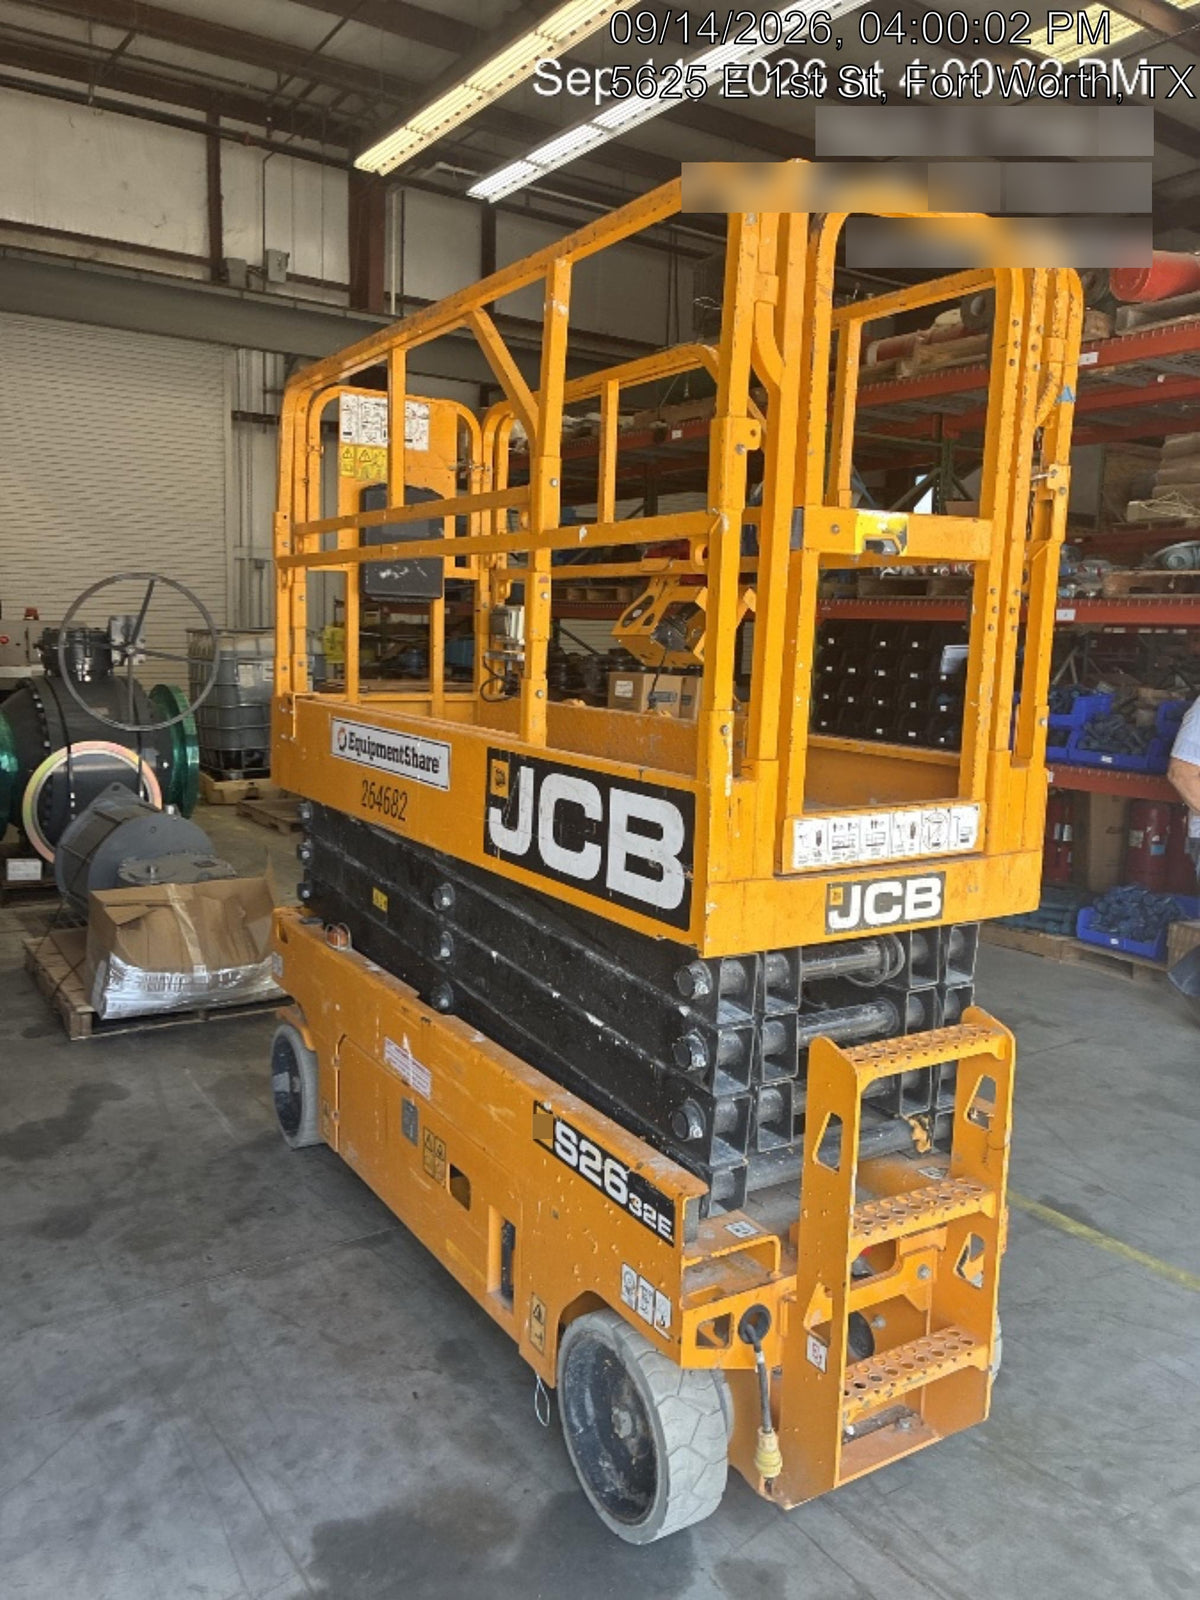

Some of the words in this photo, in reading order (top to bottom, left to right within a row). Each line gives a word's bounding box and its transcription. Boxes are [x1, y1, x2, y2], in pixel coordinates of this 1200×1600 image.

[347, 731, 440, 774] EquipmentShare
[361, 779, 408, 822] 264682
[488, 765, 685, 910] JCB
[828, 876, 943, 930] JCB
